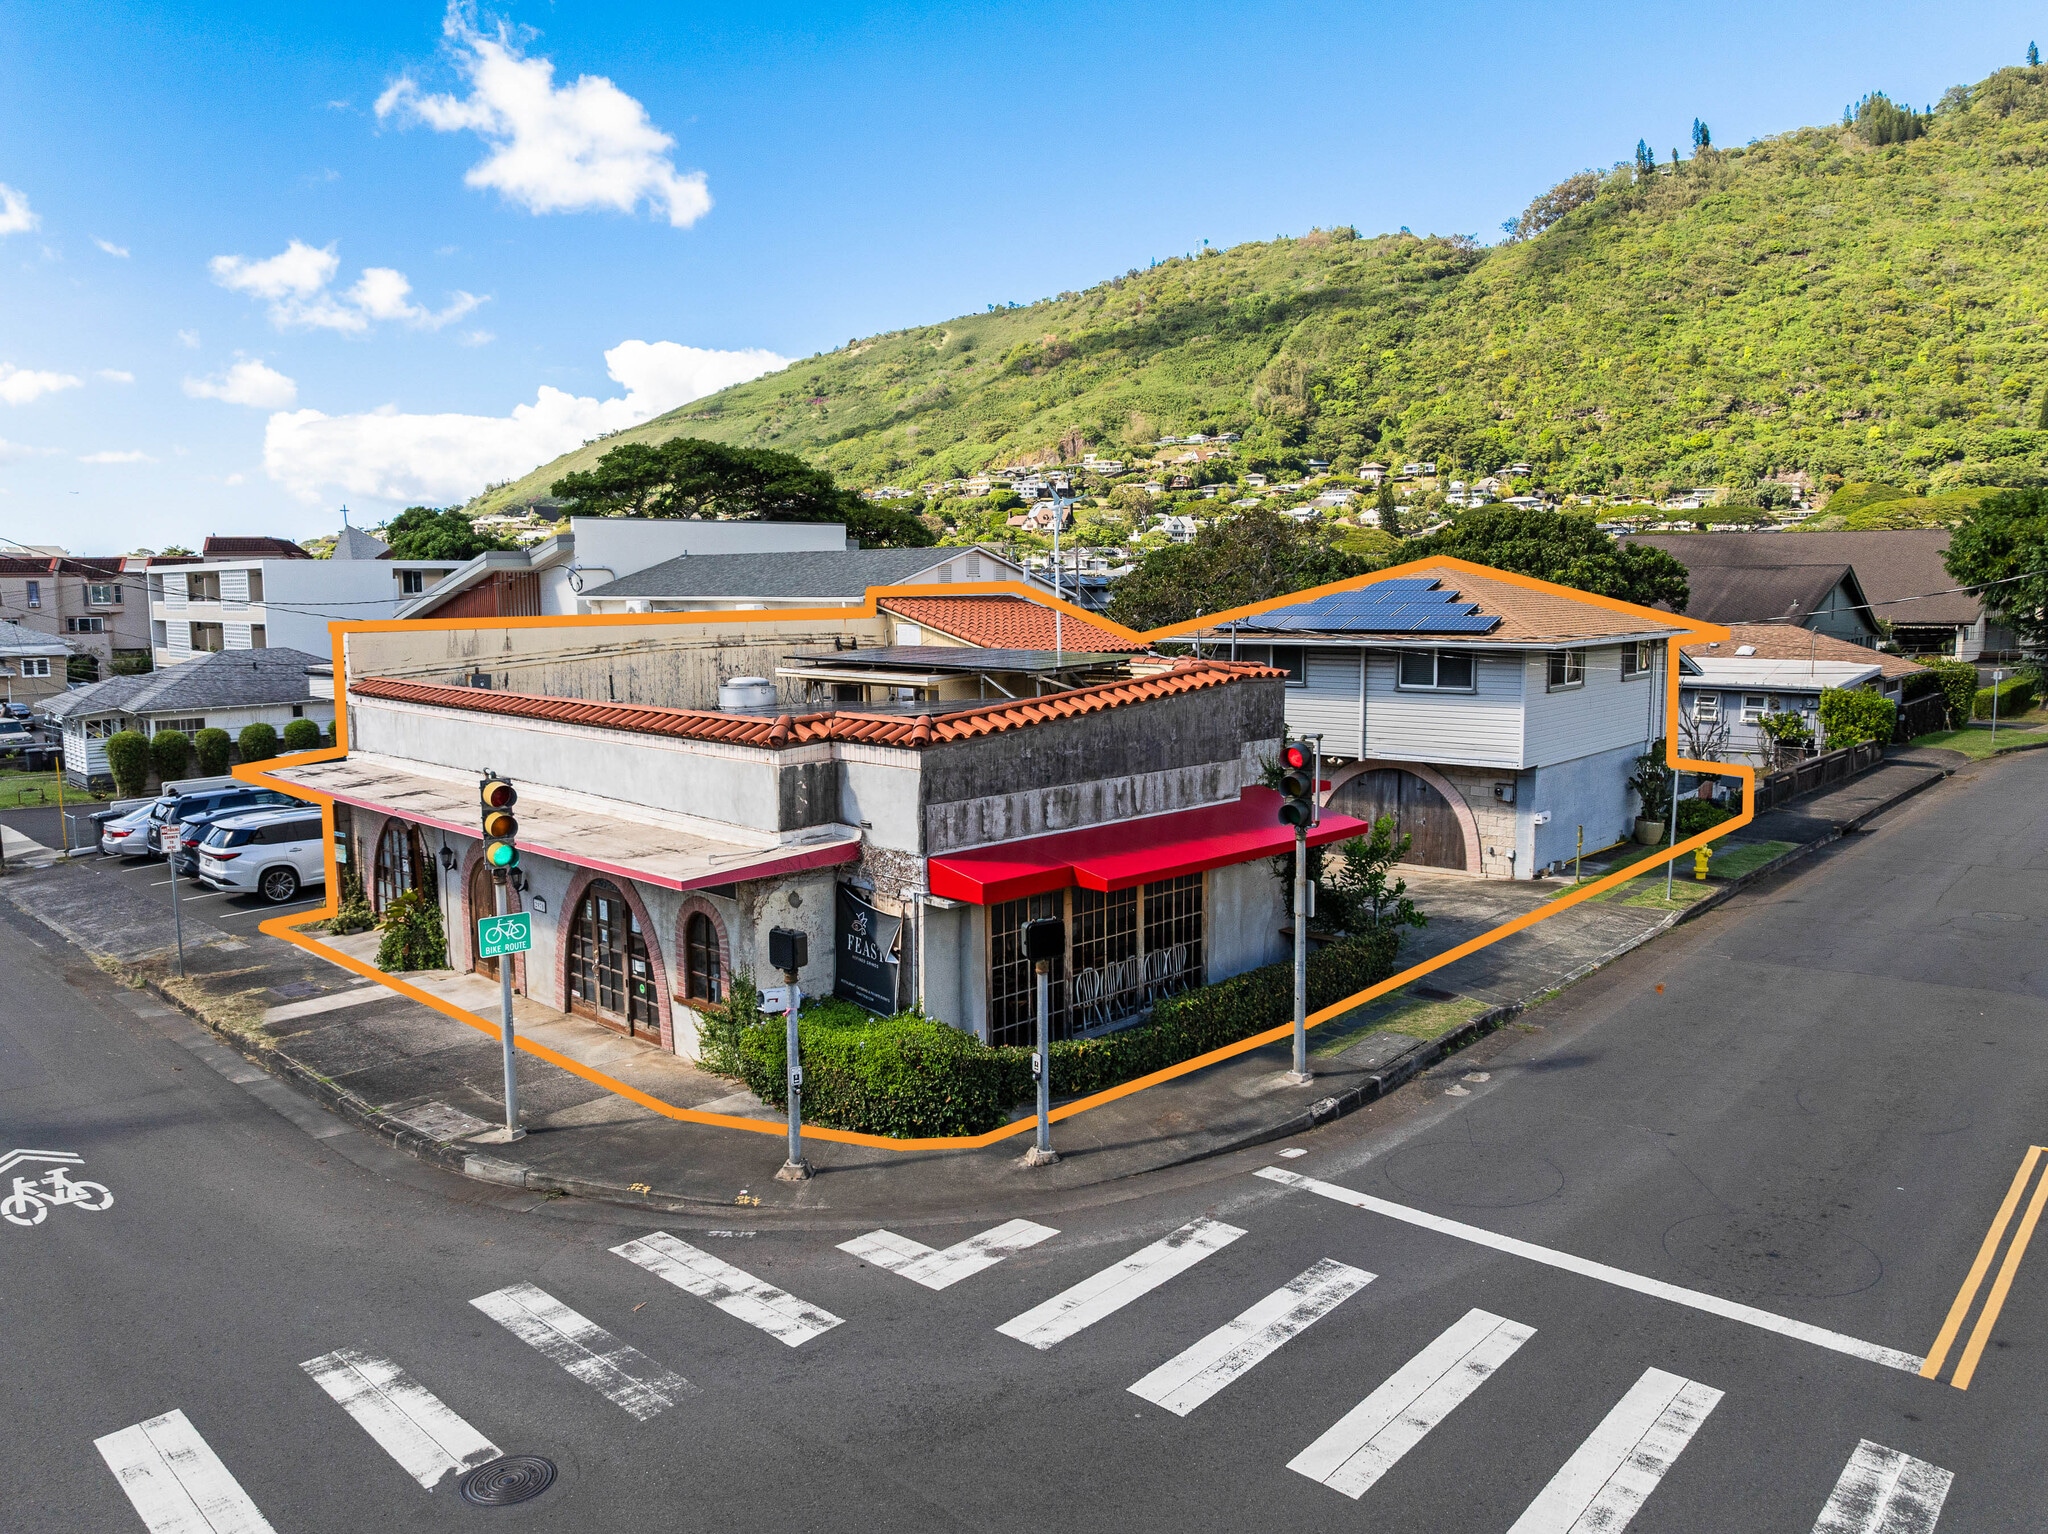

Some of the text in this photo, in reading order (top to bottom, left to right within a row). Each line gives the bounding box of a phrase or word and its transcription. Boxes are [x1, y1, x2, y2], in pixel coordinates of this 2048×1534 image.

[485, 941, 527, 954] BIKE ROUTE
[847, 933, 884, 963] FEAST
